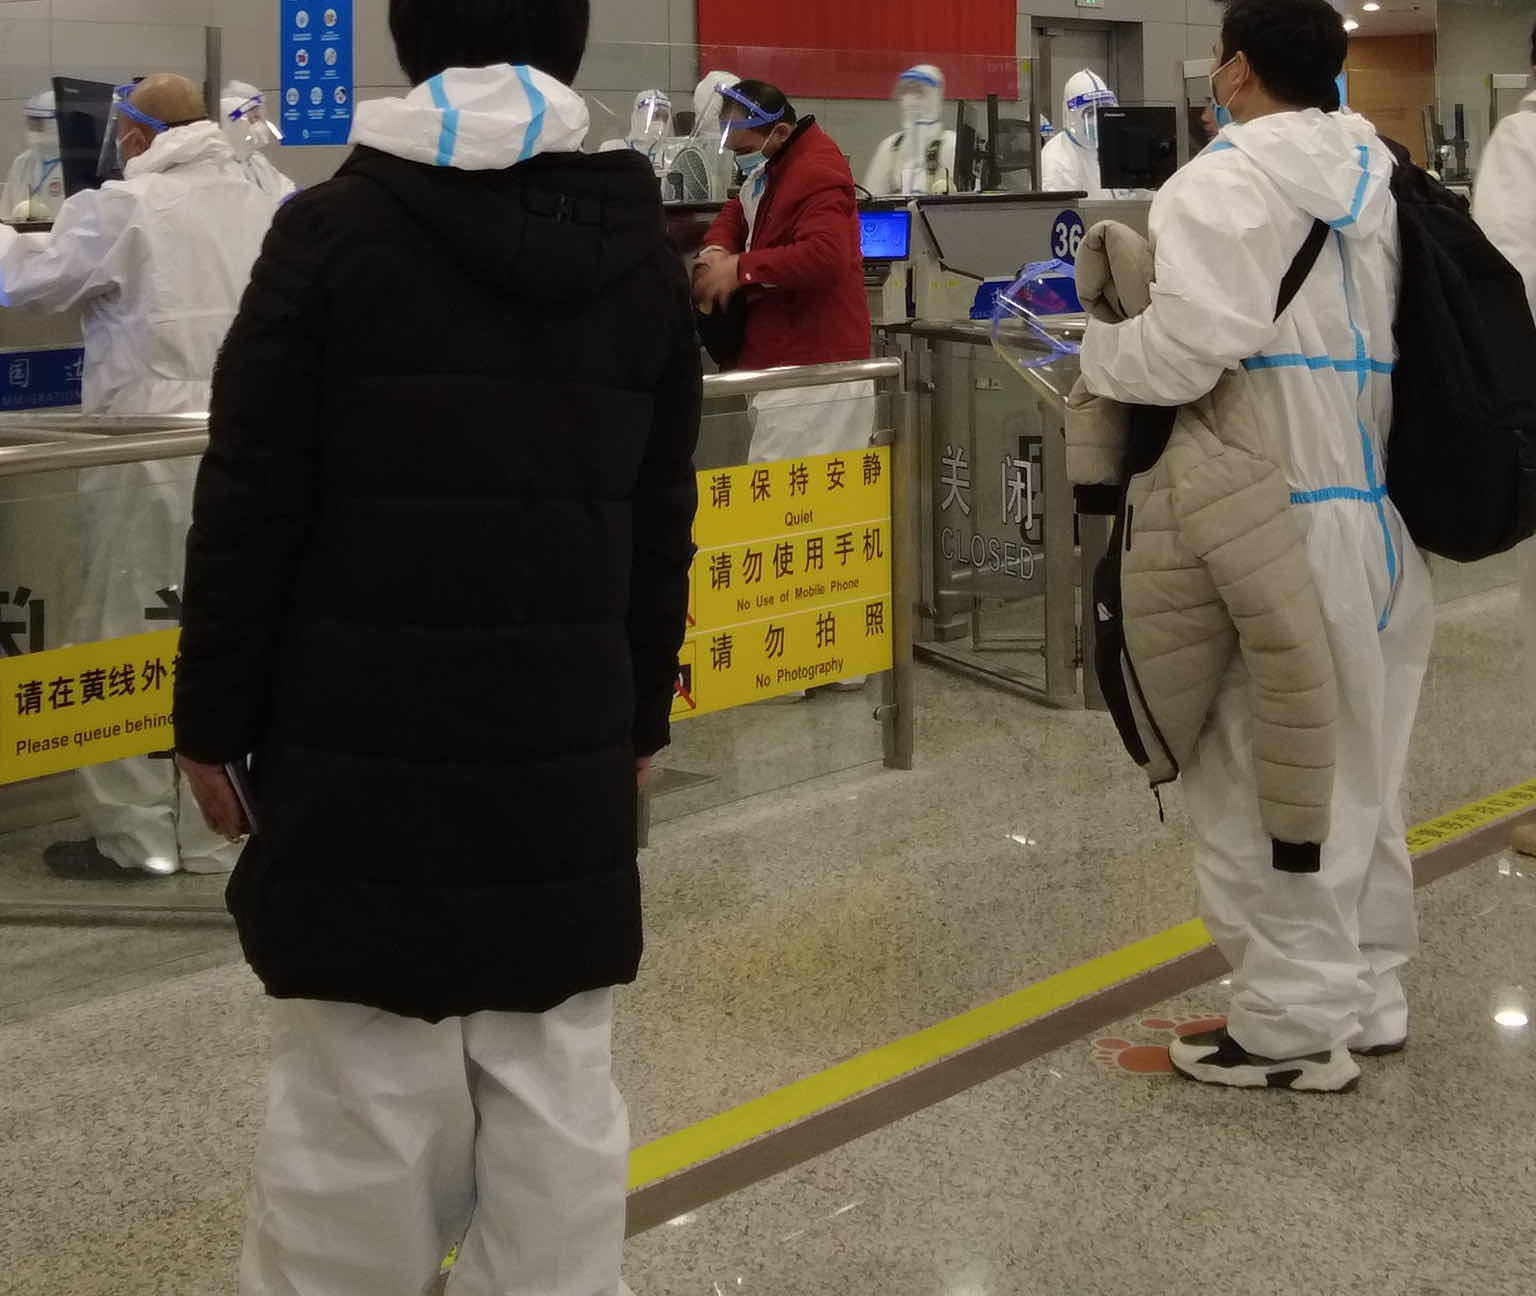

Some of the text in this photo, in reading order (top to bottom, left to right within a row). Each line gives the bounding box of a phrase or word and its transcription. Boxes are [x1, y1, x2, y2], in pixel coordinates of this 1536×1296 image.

[1055, 222, 1082, 257] 36
[709, 452, 882, 509] 请保持安静
[941, 445, 1033, 531] 关闭
[784, 510, 814, 527] Quiet
[708, 528, 884, 591] 请勿使用手机
[941, 527, 1035, 581] CLOSED
[736, 577, 860, 612] No Use of Mobile Phone
[710, 601, 885, 672] 请勿拍照
[15, 657, 182, 717] 请在黄线外
[756, 656, 844, 689] No Photography
[15, 732, 69, 756] Please
[73, 725, 121, 746] queue
